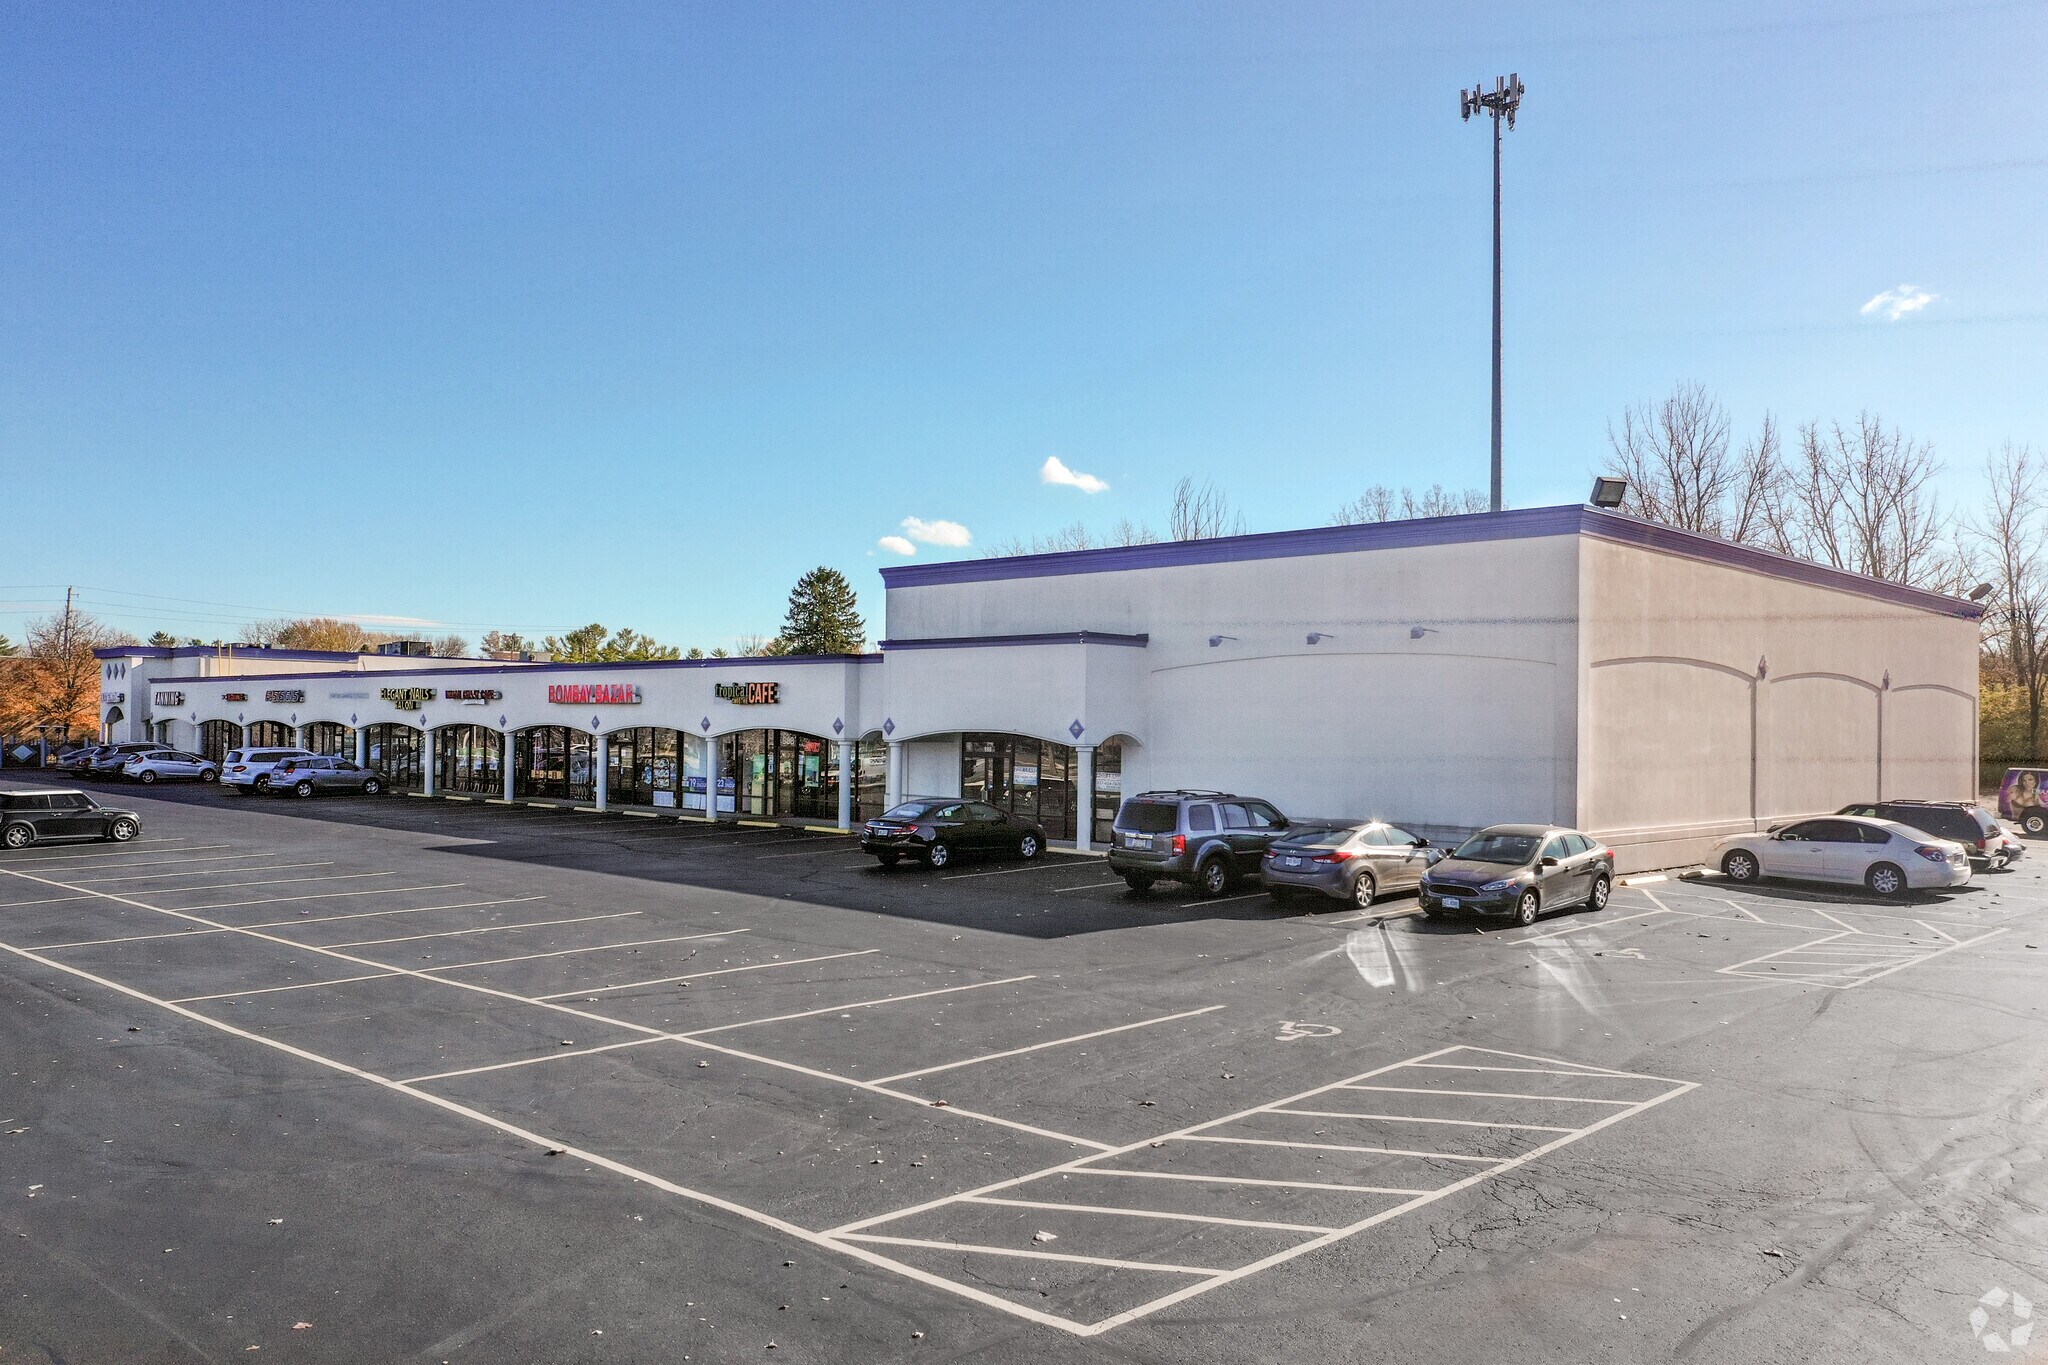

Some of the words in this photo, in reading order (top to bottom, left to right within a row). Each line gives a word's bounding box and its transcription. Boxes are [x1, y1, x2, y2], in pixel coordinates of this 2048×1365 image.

[381, 688, 408, 700] ELEGANT
[410, 687, 430, 700] NAILS
[549, 685, 592, 703] BOMBAY
[595, 684, 633, 703] BAZAR
[748, 683, 775, 703] CAFE
